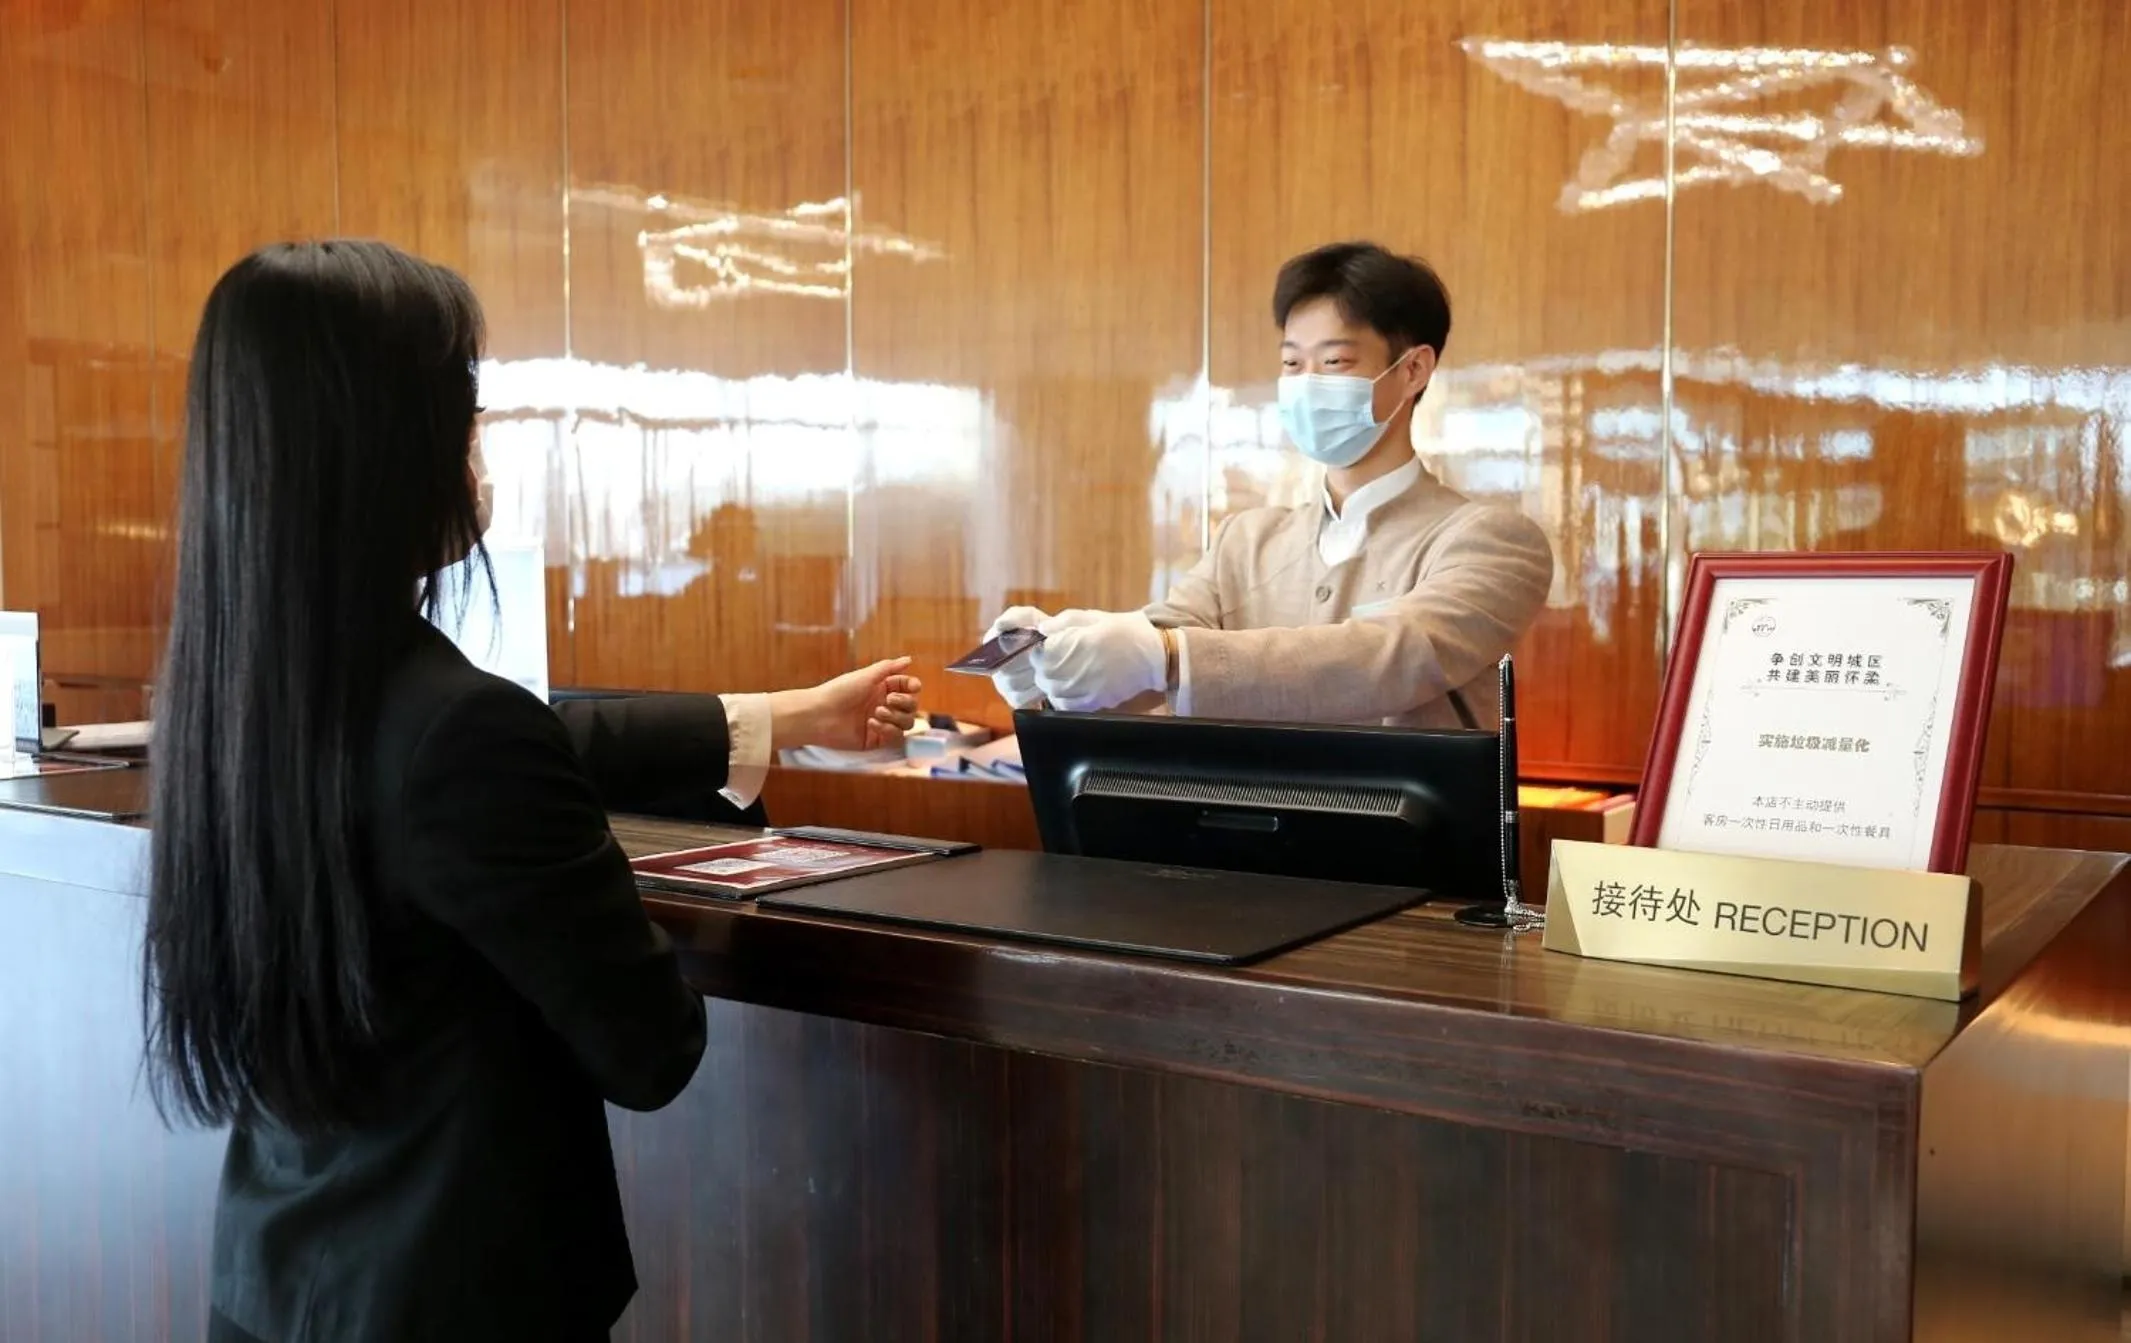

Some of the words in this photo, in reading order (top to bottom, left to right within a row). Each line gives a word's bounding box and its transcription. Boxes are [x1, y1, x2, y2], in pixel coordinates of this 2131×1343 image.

[1770, 652, 1882, 668] 争创文明城区
[1766, 668, 1880, 685] 共建美丽怀柔
[1758, 733, 1871, 753] 实施垃圾减量化
[1752, 795, 1846, 813] 本店不主动提供
[1703, 812, 1891, 839] 客房一次性日用品和一次性餐具
[1591, 880, 1701, 926] 接待处
[1713, 902, 1929, 952] RECEPTION
